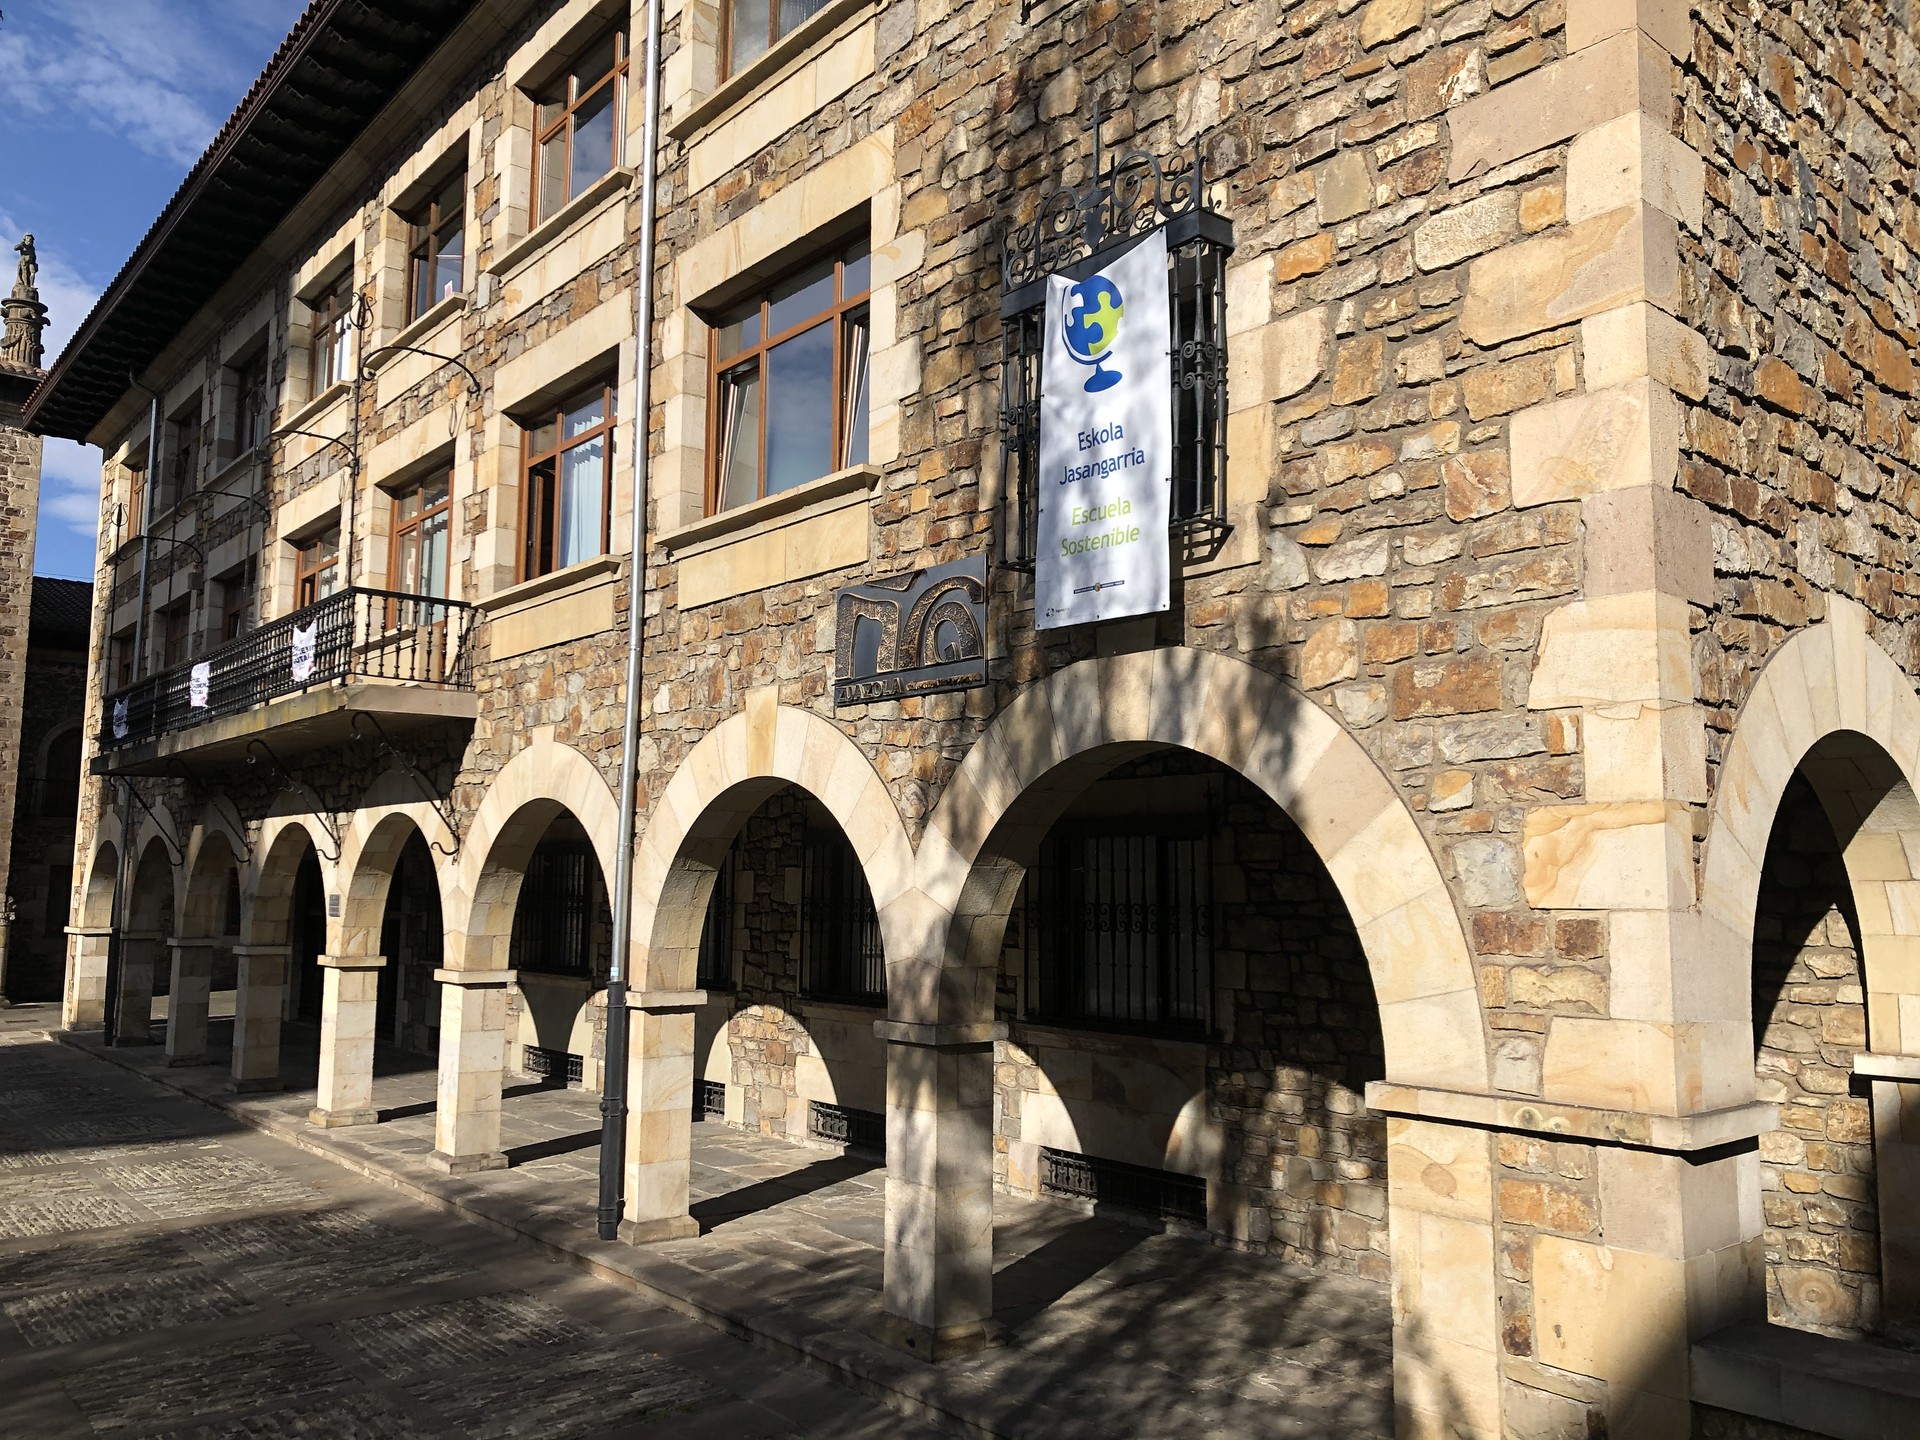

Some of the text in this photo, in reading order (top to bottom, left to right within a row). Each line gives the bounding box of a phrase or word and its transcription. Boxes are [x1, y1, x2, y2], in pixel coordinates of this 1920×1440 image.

[1077, 422, 1124, 451] Eskola
[1059, 447, 1145, 485] Jasangarria
[1071, 496, 1132, 526] Escuela
[1061, 525, 1140, 557] Sostenible
